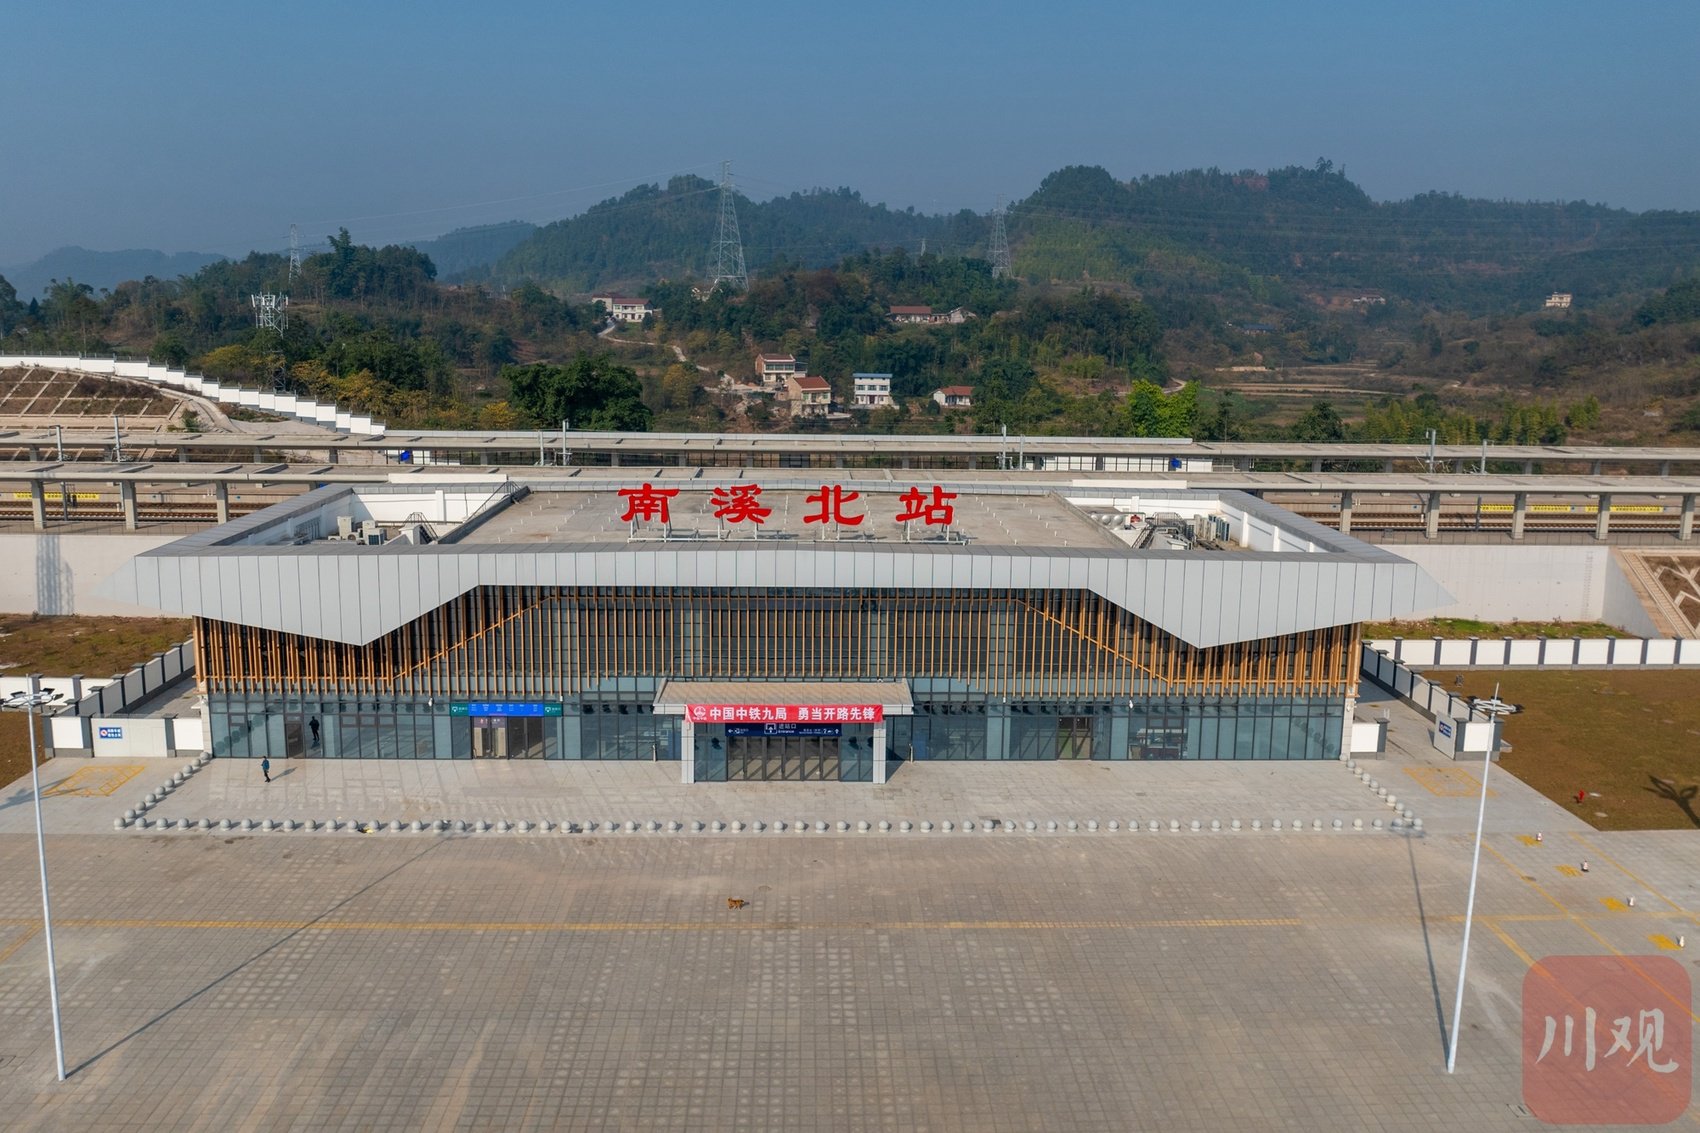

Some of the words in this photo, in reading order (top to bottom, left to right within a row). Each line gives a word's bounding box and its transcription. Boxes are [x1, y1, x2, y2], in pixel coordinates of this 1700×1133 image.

[617, 483, 957, 525] 南溪北站
[710, 707, 787, 720] 中国中铁九局
[798, 707, 875, 720] 勇当开路先锋
